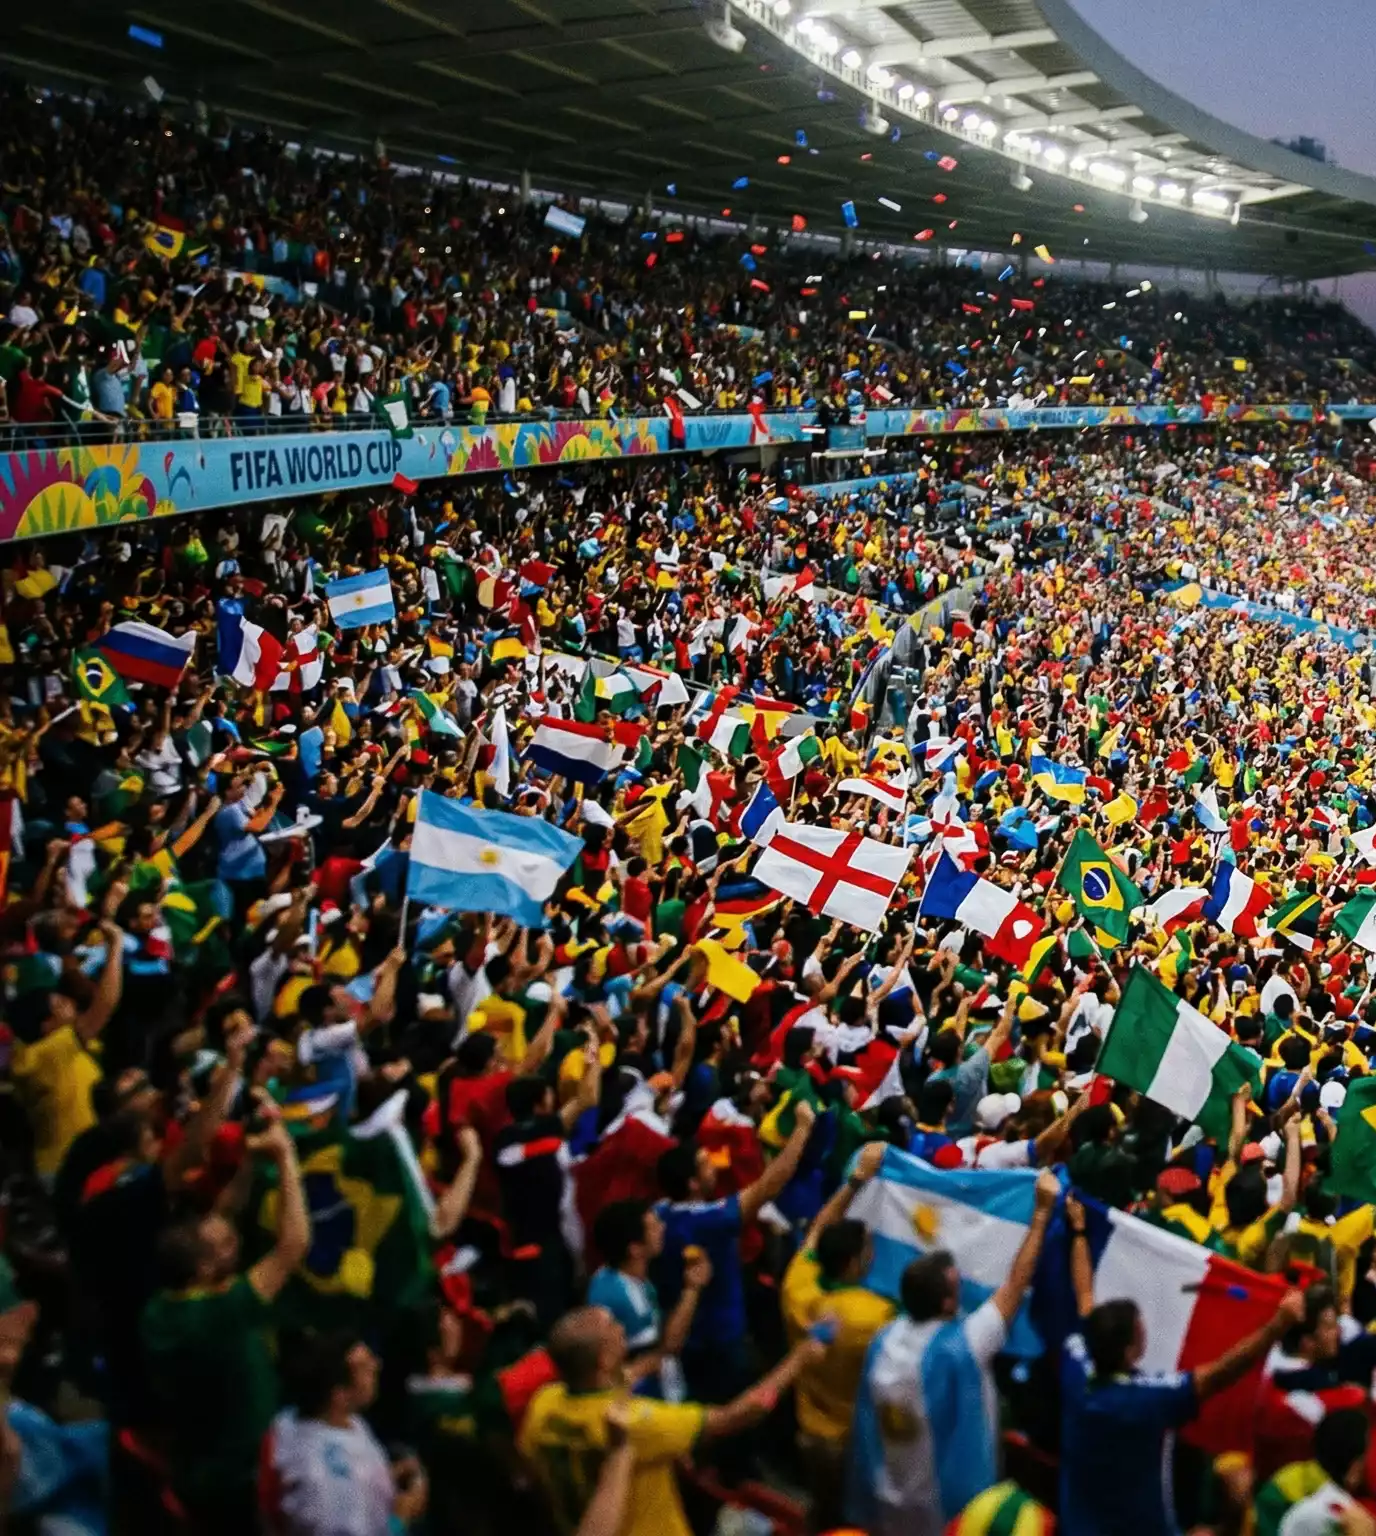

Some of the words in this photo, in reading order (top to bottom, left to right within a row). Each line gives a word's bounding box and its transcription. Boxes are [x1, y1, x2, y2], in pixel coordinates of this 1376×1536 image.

[230, 449, 283, 492] FIFA
[284, 445, 362, 485] WORLD
[366, 440, 403, 475] CUP
